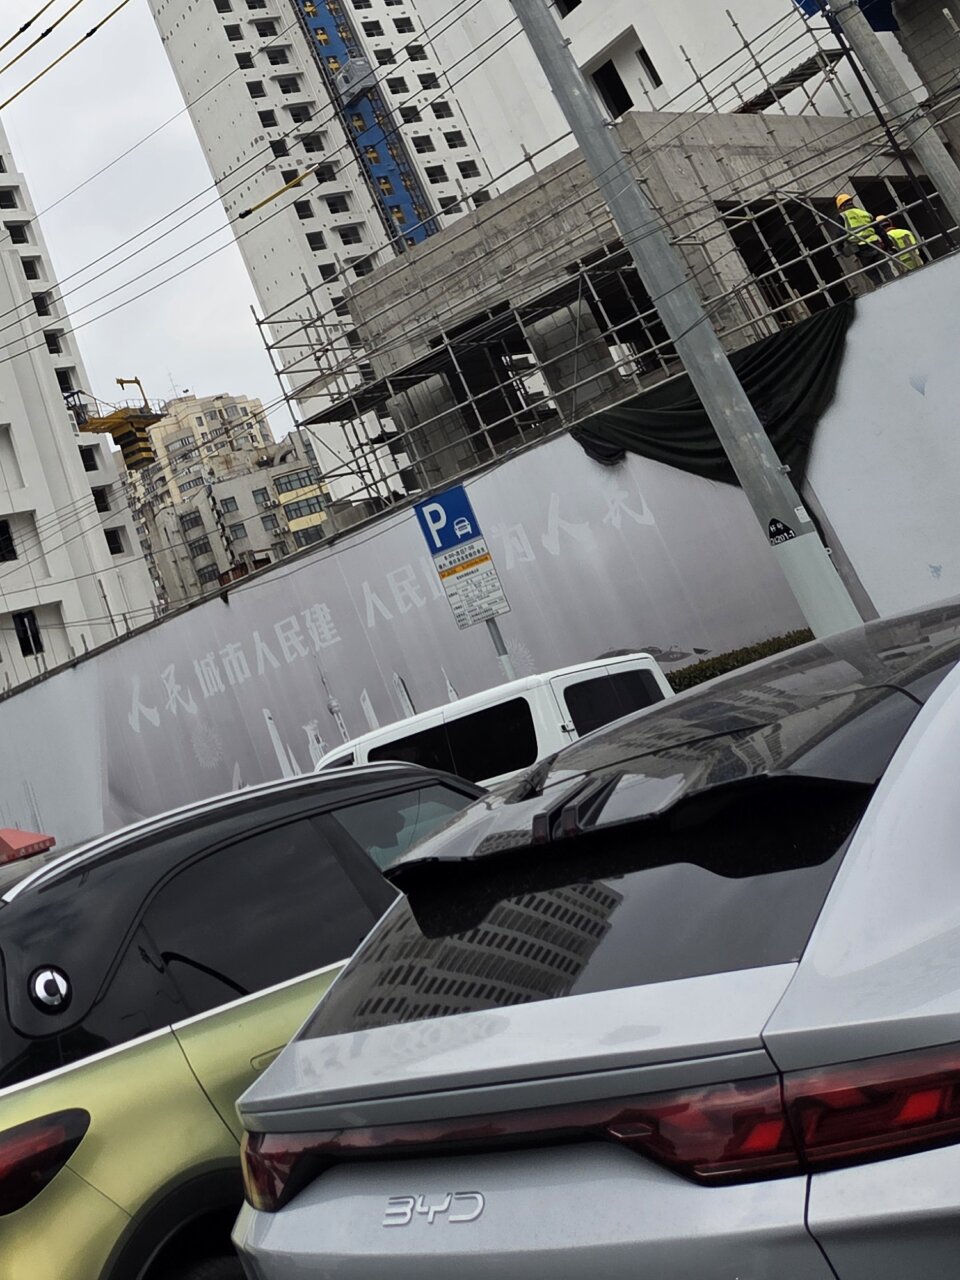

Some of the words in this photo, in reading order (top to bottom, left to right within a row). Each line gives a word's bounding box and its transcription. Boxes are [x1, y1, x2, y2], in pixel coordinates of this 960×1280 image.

[359, 484, 656, 629] 人民为人民
[422, 502, 447, 549] P
[128, 602, 342, 734] 人民城市人民建
[381, 1190, 486, 1228] BYD
